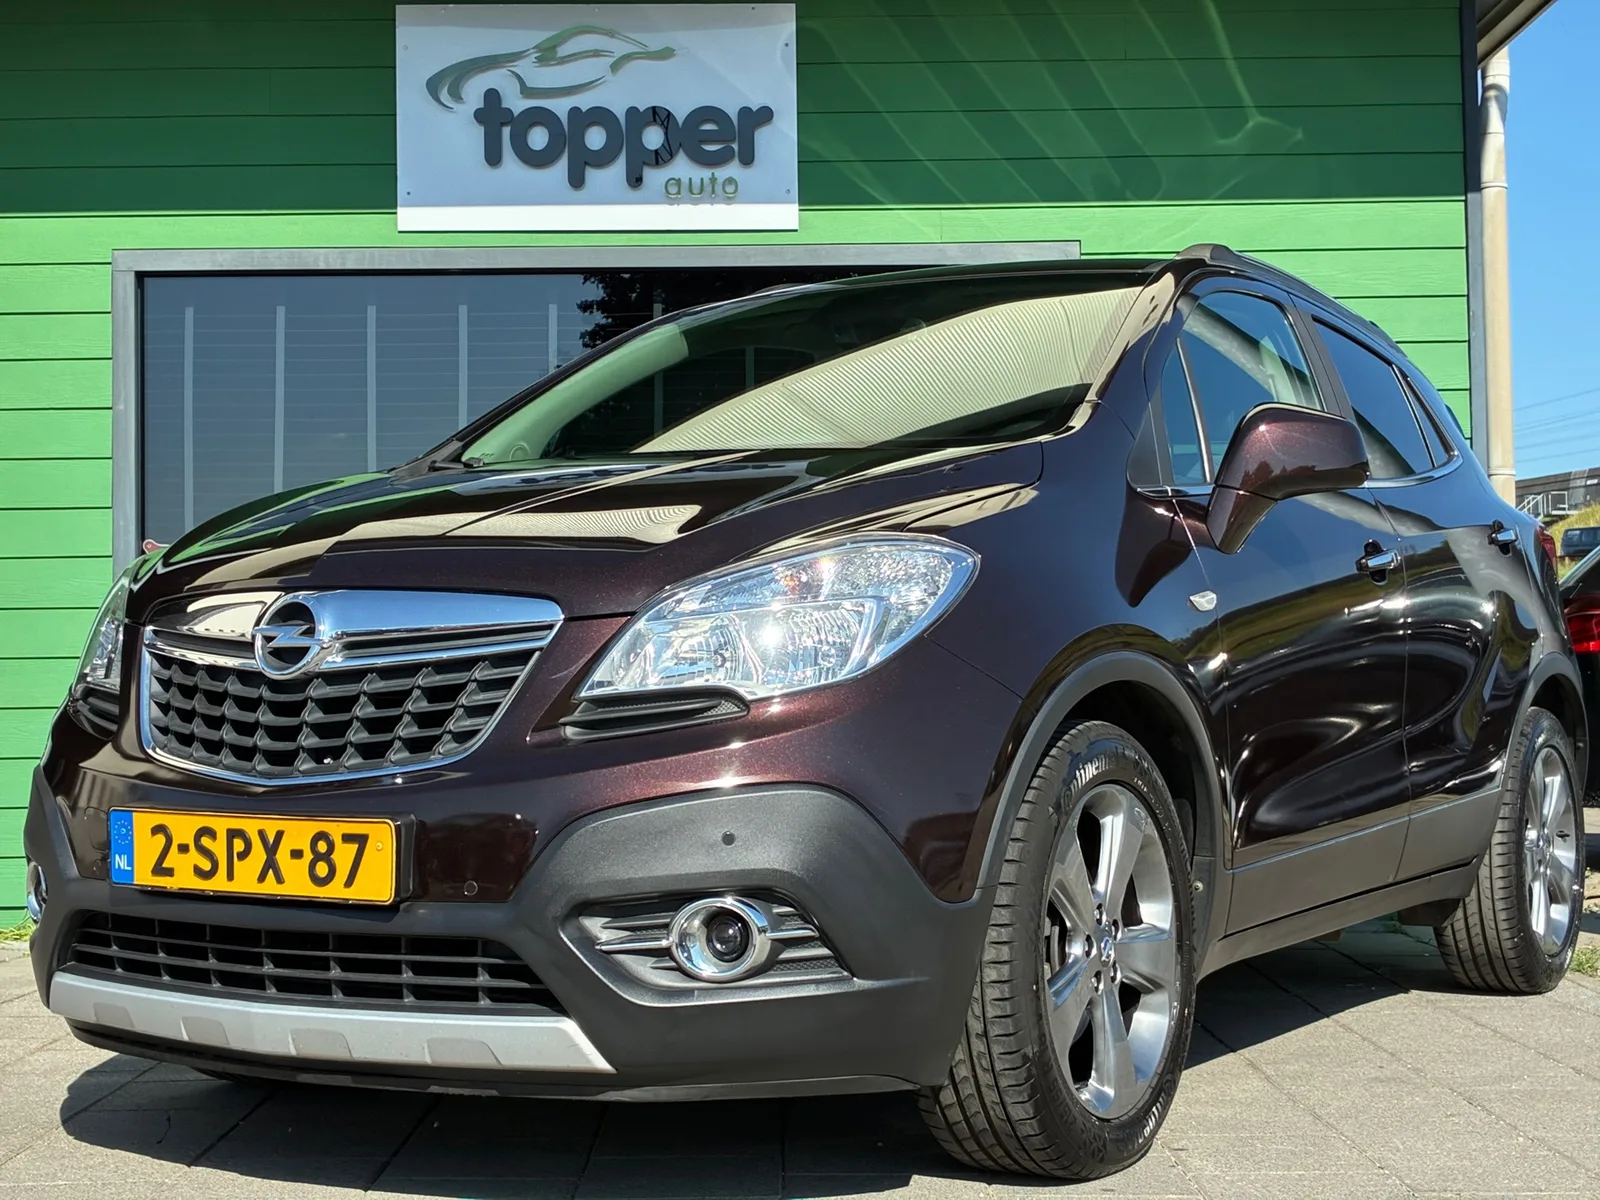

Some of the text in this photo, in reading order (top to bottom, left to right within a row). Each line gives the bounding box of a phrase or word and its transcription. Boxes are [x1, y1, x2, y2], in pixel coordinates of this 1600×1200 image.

[473, 88, 774, 189] topper
[664, 171, 739, 198] auto
[115, 854, 132, 871] NL
[150, 823, 370, 889] 2-SPX-87
